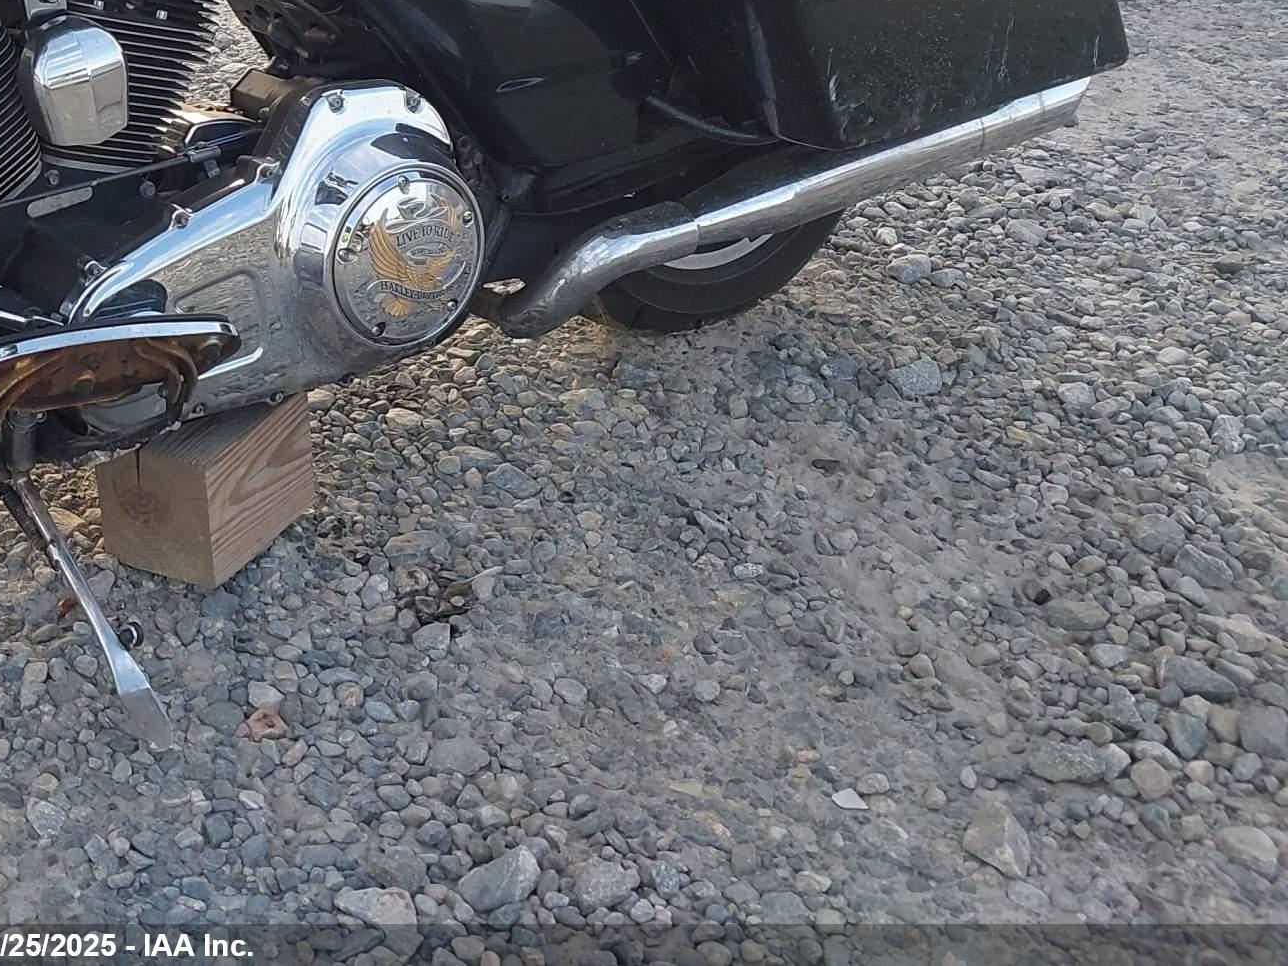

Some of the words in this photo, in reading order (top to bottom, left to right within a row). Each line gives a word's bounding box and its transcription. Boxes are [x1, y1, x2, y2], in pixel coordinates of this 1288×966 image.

[396, 229, 421, 247] LIVE
[421, 224, 433, 237] TO
[434, 225, 455, 242] RIDE
